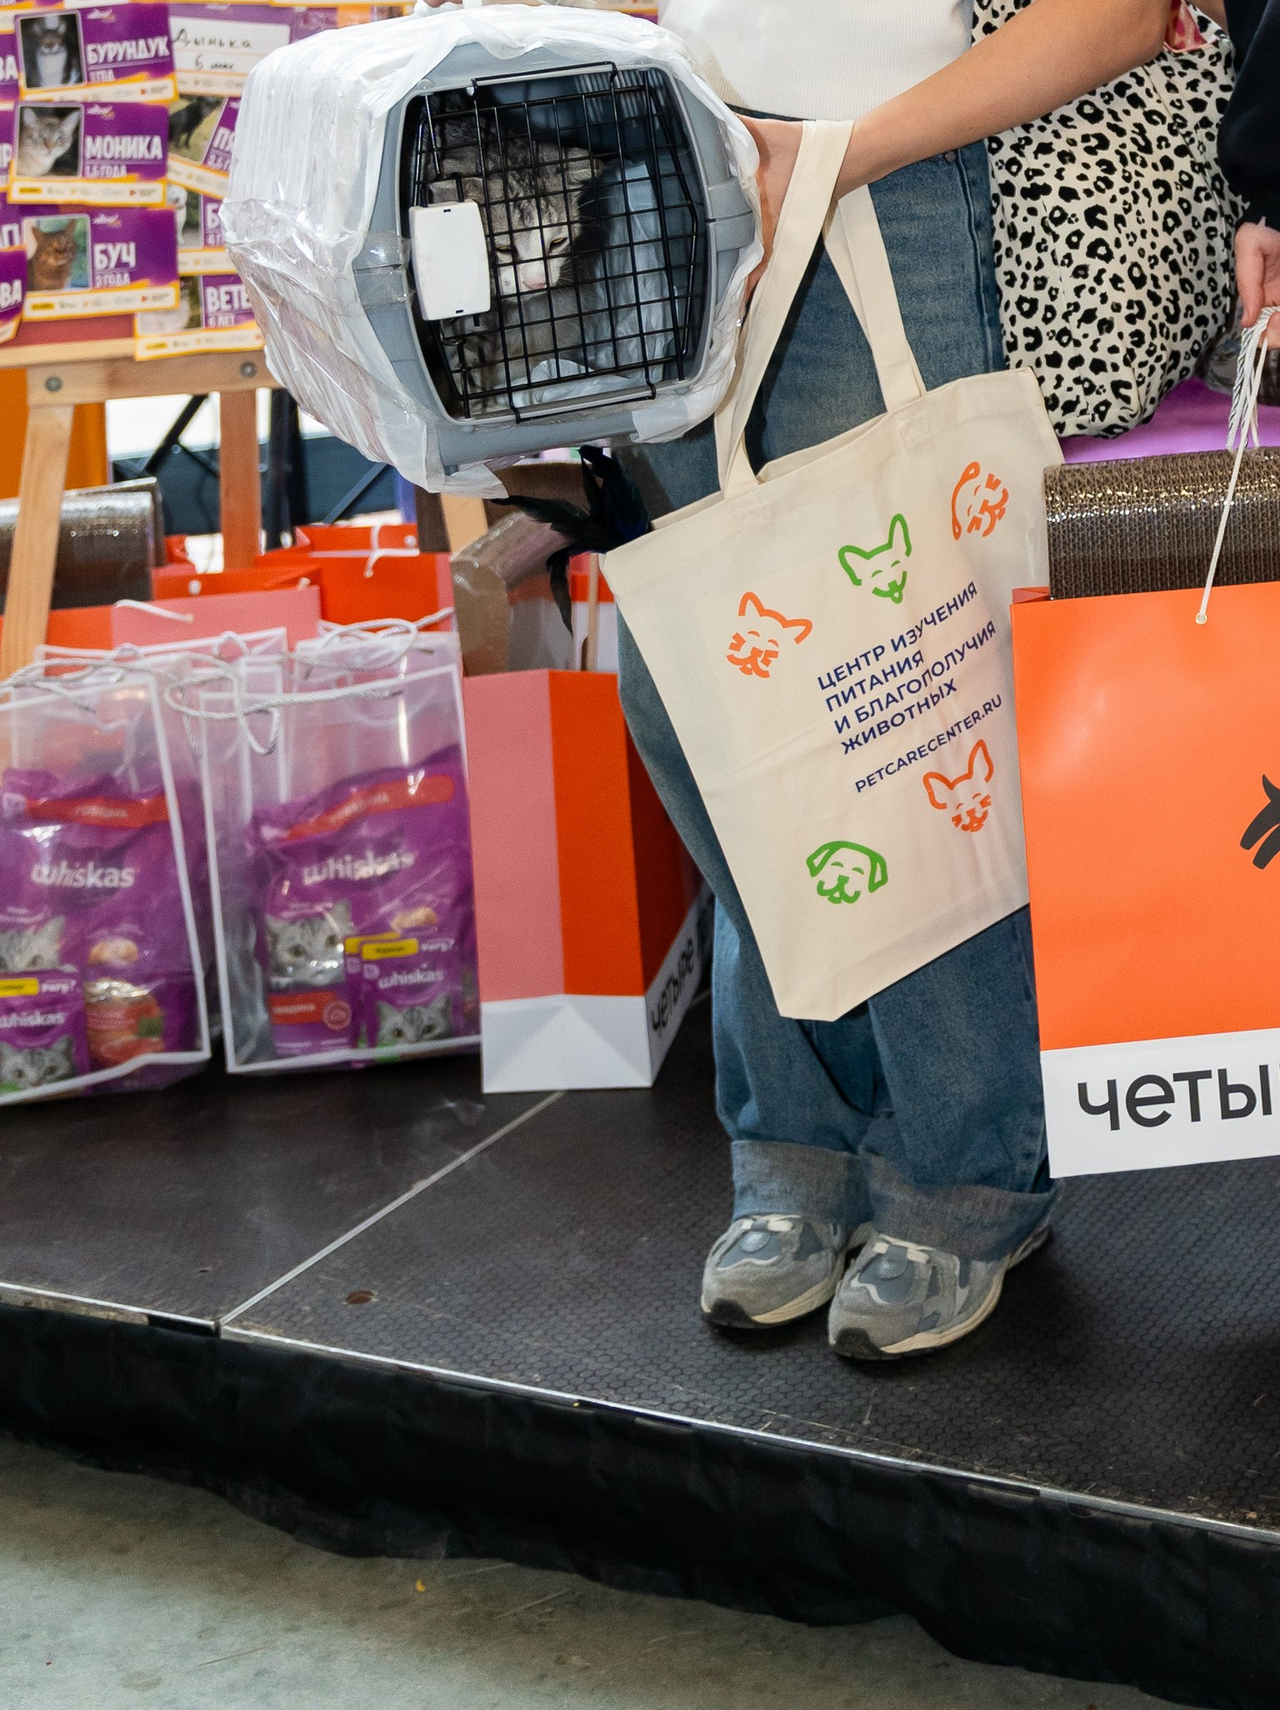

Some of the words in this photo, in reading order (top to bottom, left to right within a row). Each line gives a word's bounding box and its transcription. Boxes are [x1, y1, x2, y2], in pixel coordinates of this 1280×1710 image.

[86, 37, 170, 65] БУРУНДУК
[85, 135, 163, 160] МОНИКА
[94, 242, 136, 270] БУЧ
[816, 643, 886, 691] ЦЕНТР
[890, 581, 978, 653] ИЗУЧЕНИЯ
[825, 649, 925, 713] ПИТАНИЯ
[833, 714, 852, 735] И
[854, 620, 997, 726] БЛАГОПОЛУЧИЯ
[841, 678, 958, 755] ЖИВОТНЫХ
[854, 694, 1003, 793] PETCARECENTER.RU
[31, 861, 135, 888] whiskas
